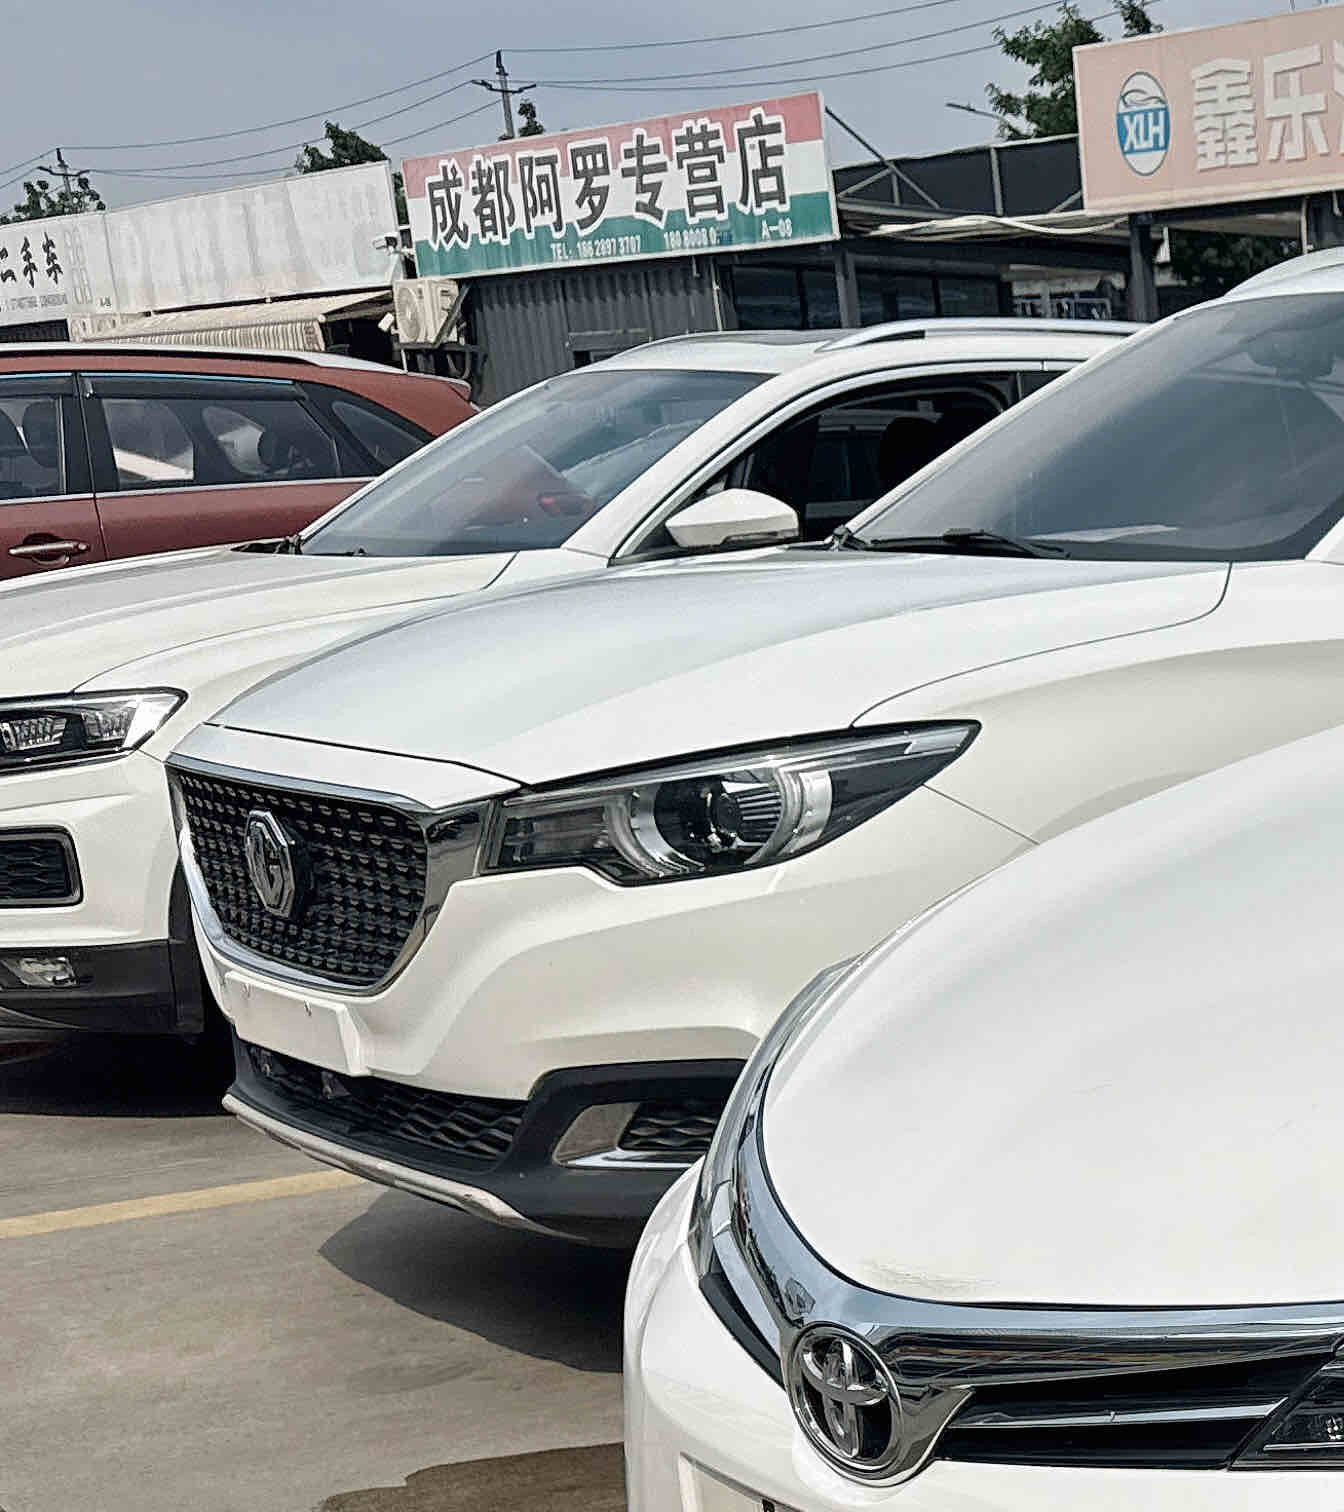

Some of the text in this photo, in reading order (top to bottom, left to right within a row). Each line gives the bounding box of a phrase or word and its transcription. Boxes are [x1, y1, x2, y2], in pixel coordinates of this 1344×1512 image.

[1123, 110, 1165, 153] XLH
[428, 112, 789, 244] 成都阿罗专营店
